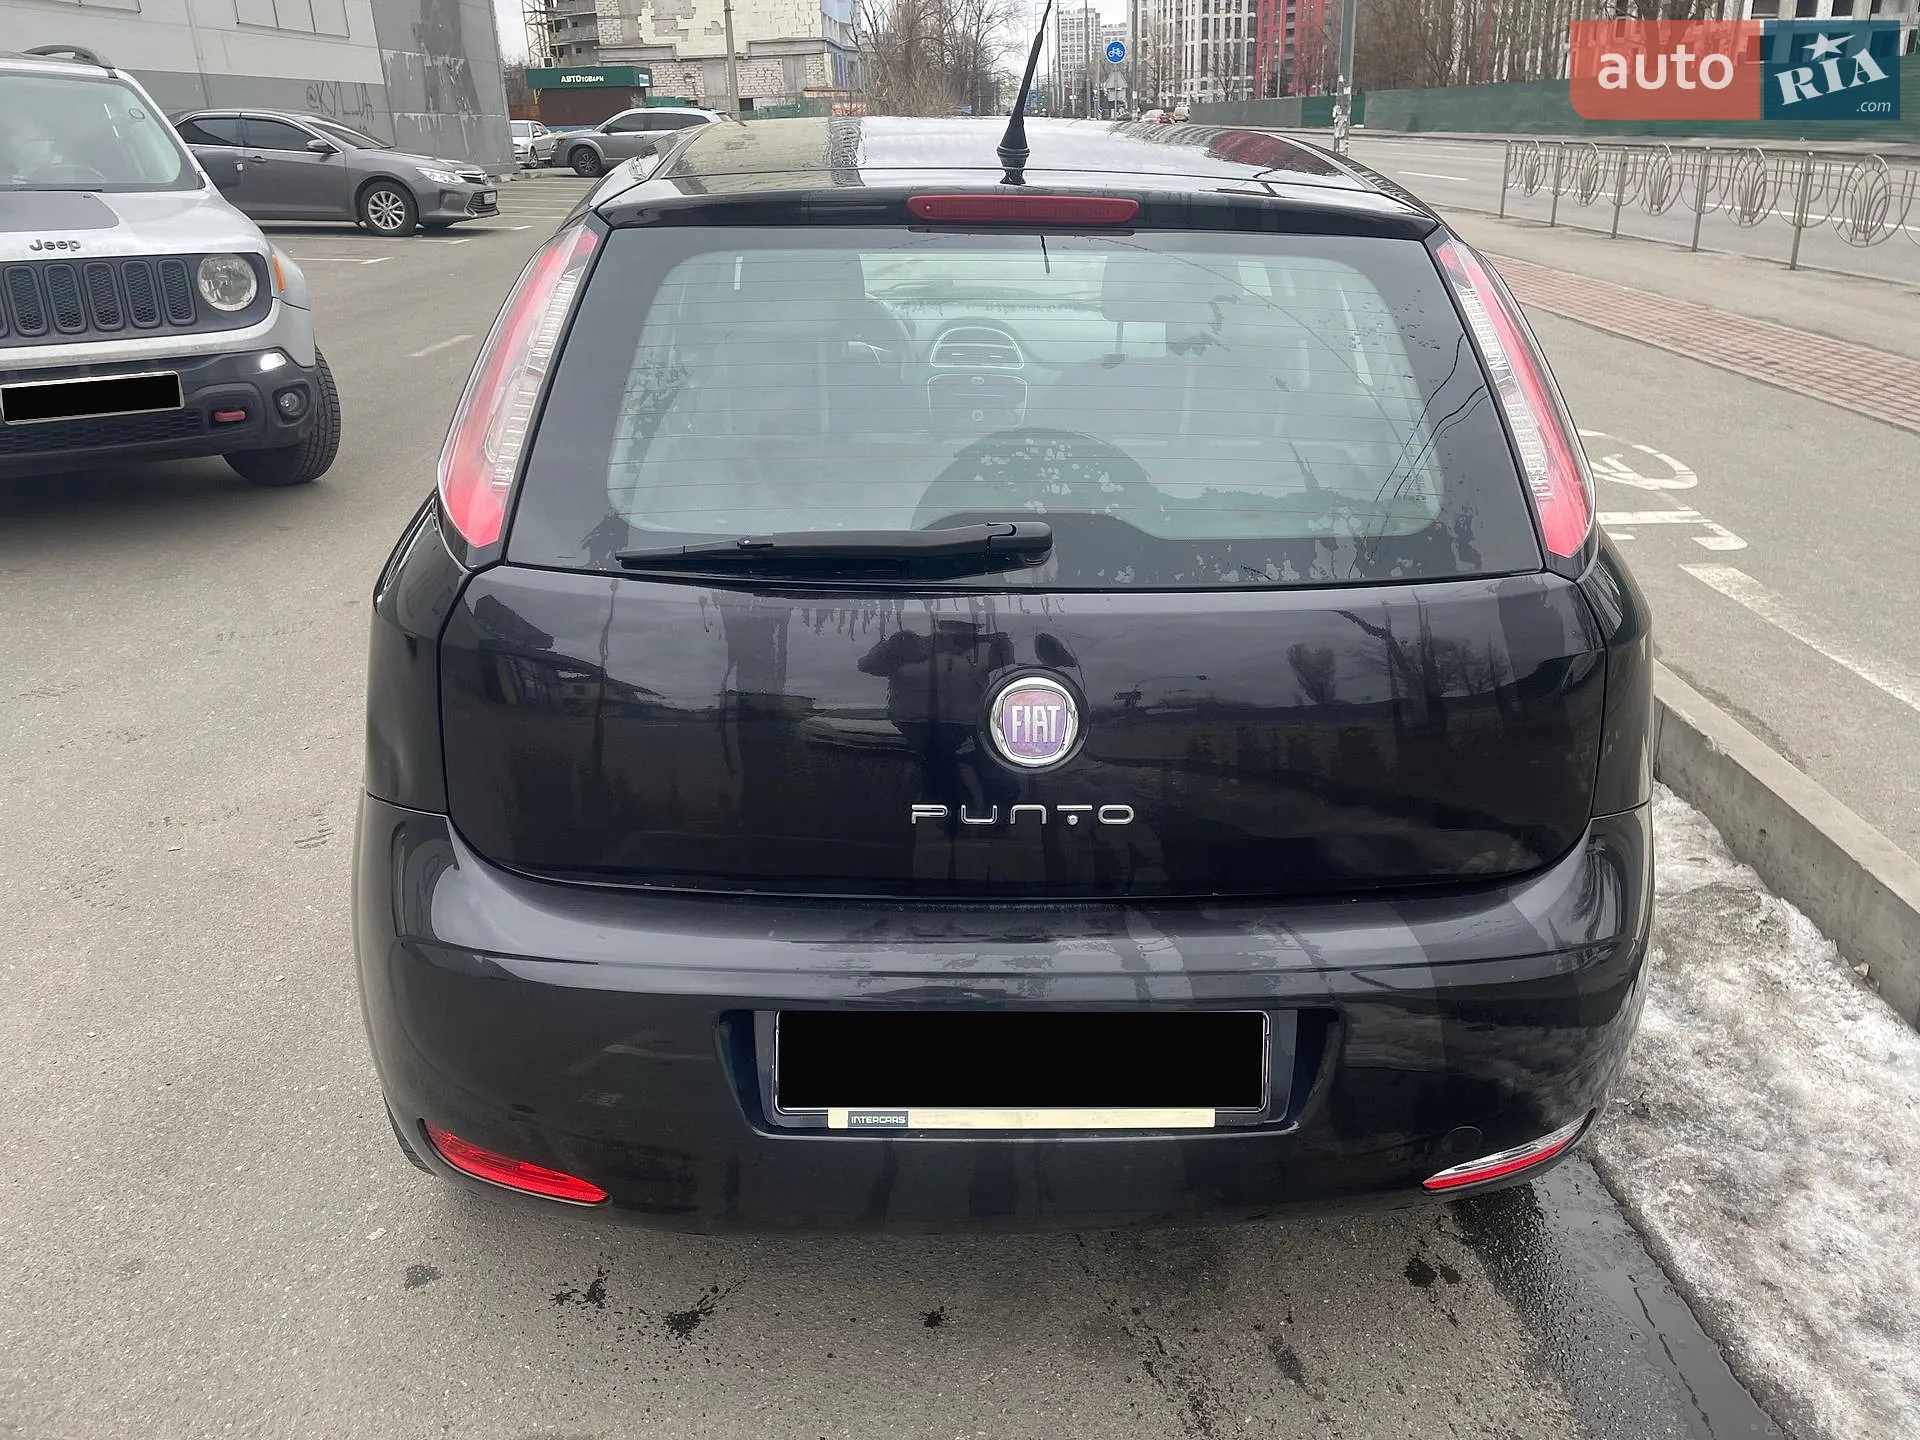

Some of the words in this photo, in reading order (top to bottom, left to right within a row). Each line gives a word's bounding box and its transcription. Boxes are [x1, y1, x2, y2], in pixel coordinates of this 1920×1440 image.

[28, 239, 81, 252] Jeep
[1011, 705, 1061, 743] FIAT
[911, 804, 1135, 826] PUNTO
